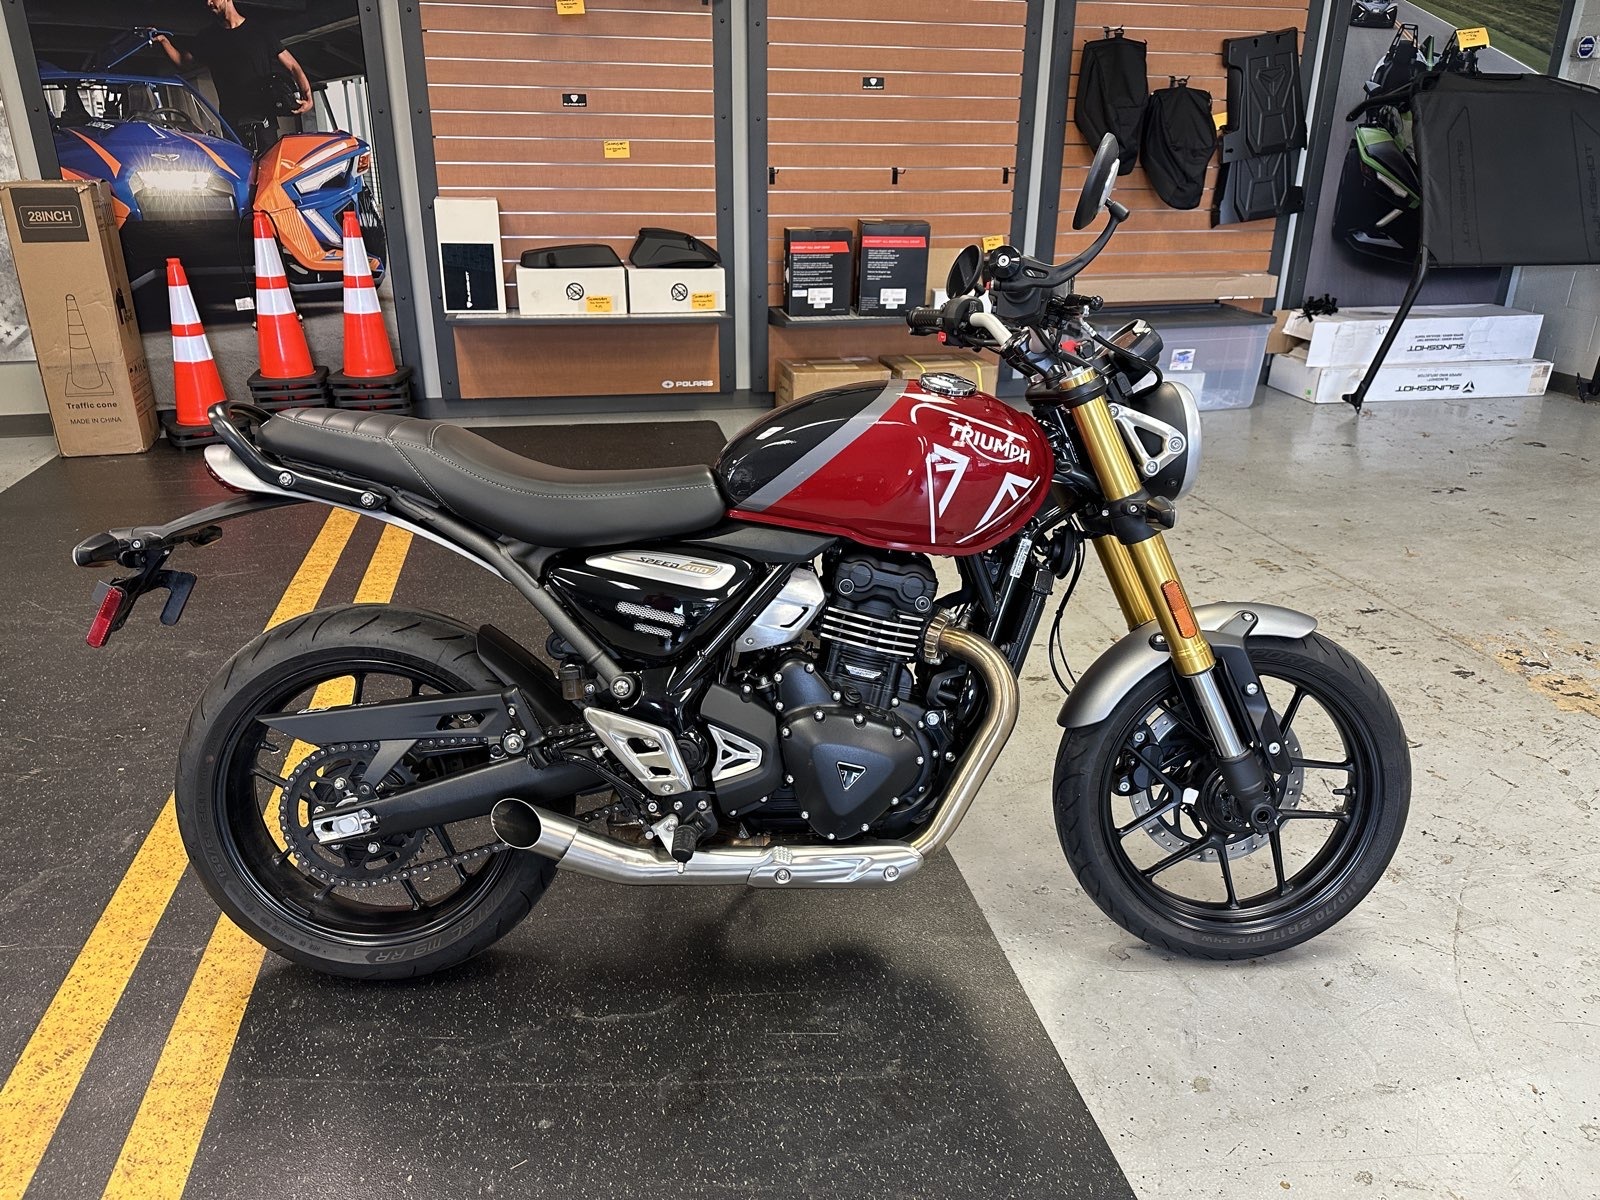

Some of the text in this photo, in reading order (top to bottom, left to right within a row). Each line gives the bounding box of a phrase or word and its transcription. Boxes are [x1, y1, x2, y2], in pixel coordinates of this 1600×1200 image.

[27, 210, 73, 222] 28INCH
[1406, 343, 1466, 352] SLINGSHOT
[1395, 384, 1461, 392] SLINGSHOT
[66, 402, 95, 410] Traffic
[70, 417, 90, 425] MADE
[948, 421, 1031, 465] TRIUMPH
[637, 556, 710, 574] SPEED 400
[374, 948, 409, 962] RR
